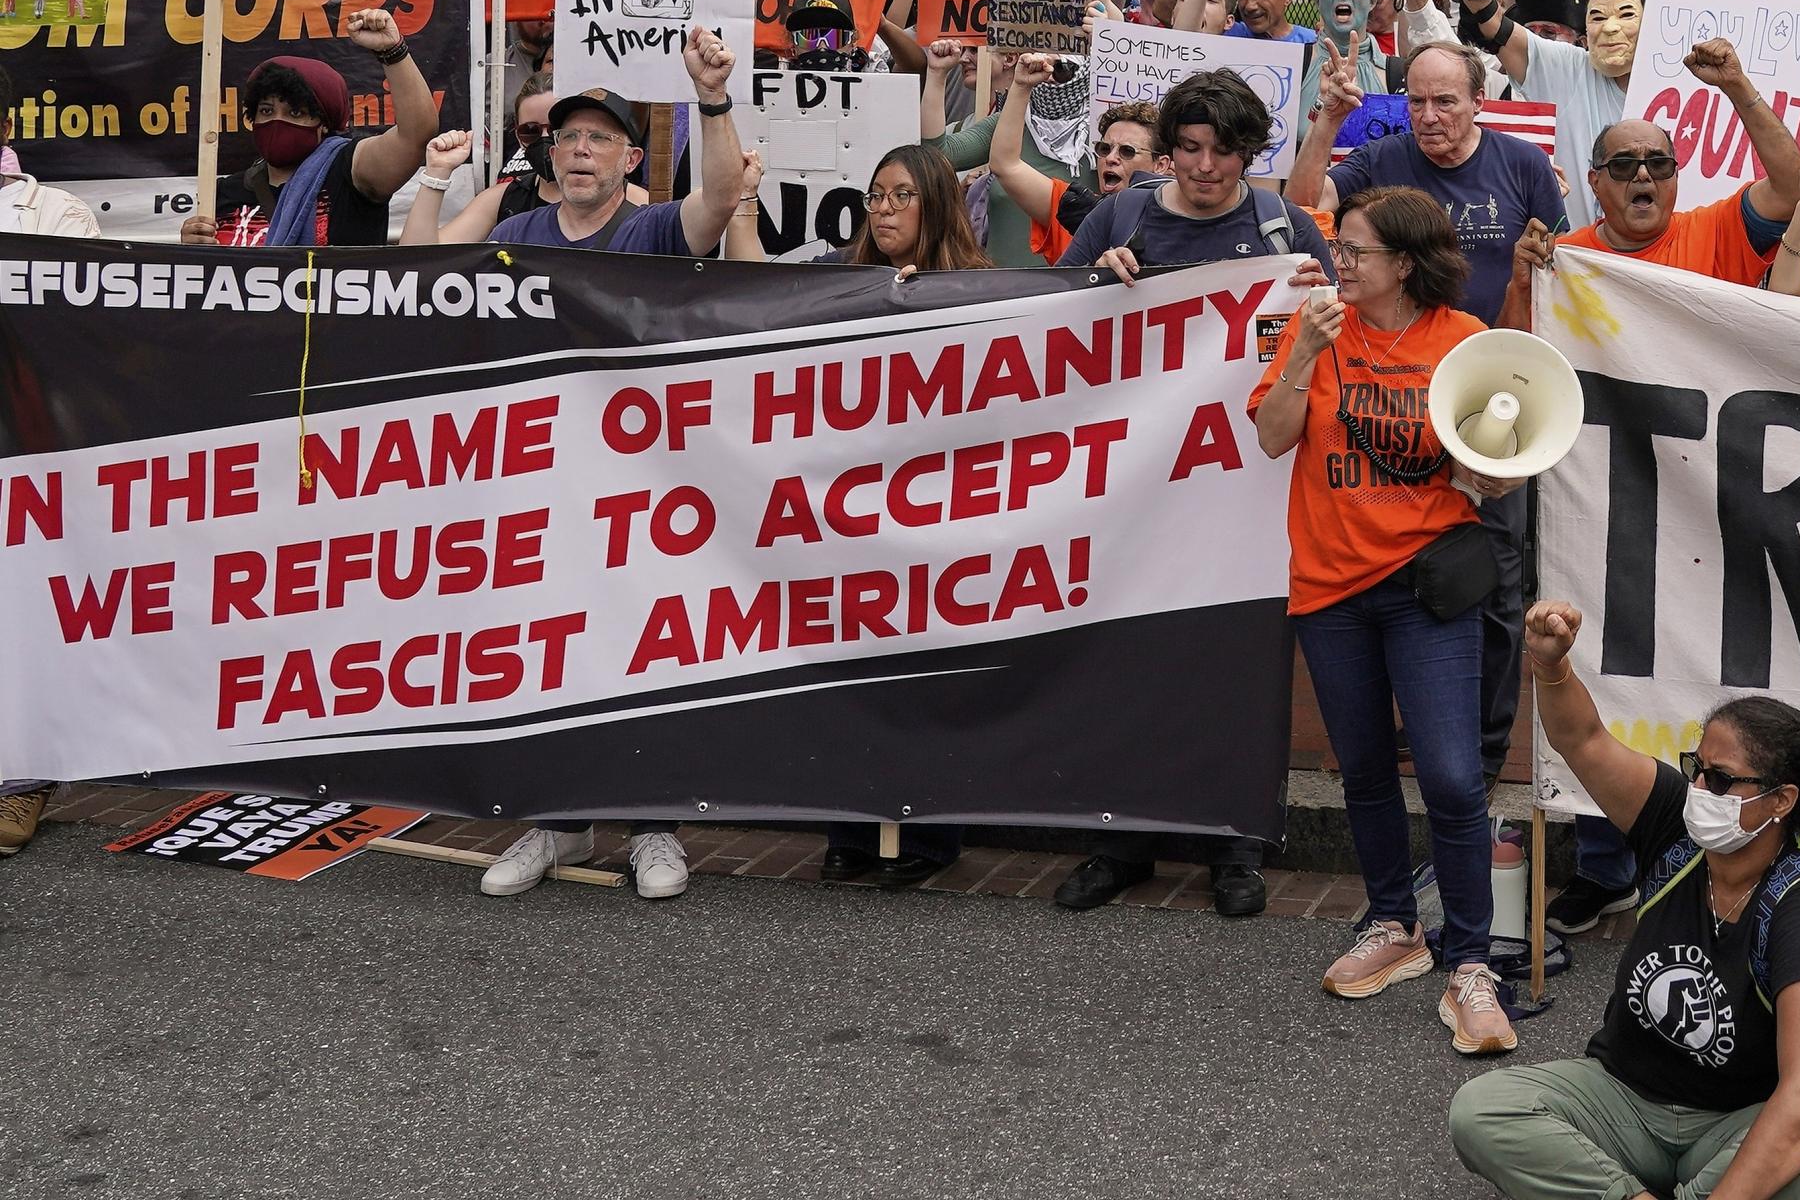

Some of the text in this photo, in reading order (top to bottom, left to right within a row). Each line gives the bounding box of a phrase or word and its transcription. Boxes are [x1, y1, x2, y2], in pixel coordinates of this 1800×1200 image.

[987, 27, 1052, 47] BECOMES
[1098, 29, 1206, 61] SOMETIMES
[1096, 56, 1182, 84] YOU HAVE
[140, 86, 189, 135] of
[0, 261, 557, 320] EFUSEFASCISM.ORG
[97, 279, 1276, 534] THE NAME OF HUMANITY
[1326, 453, 1361, 488] GO
[48, 401, 1243, 644] WE REFUSE TO ACCEPT A
[216, 536, 1091, 731] FASCIST AMERICA!
[199, 801, 313, 849] VAYA
[219, 801, 351, 863] TRUMP
[302, 820, 383, 854] YA!
[1669, 944, 1702, 964] TO
